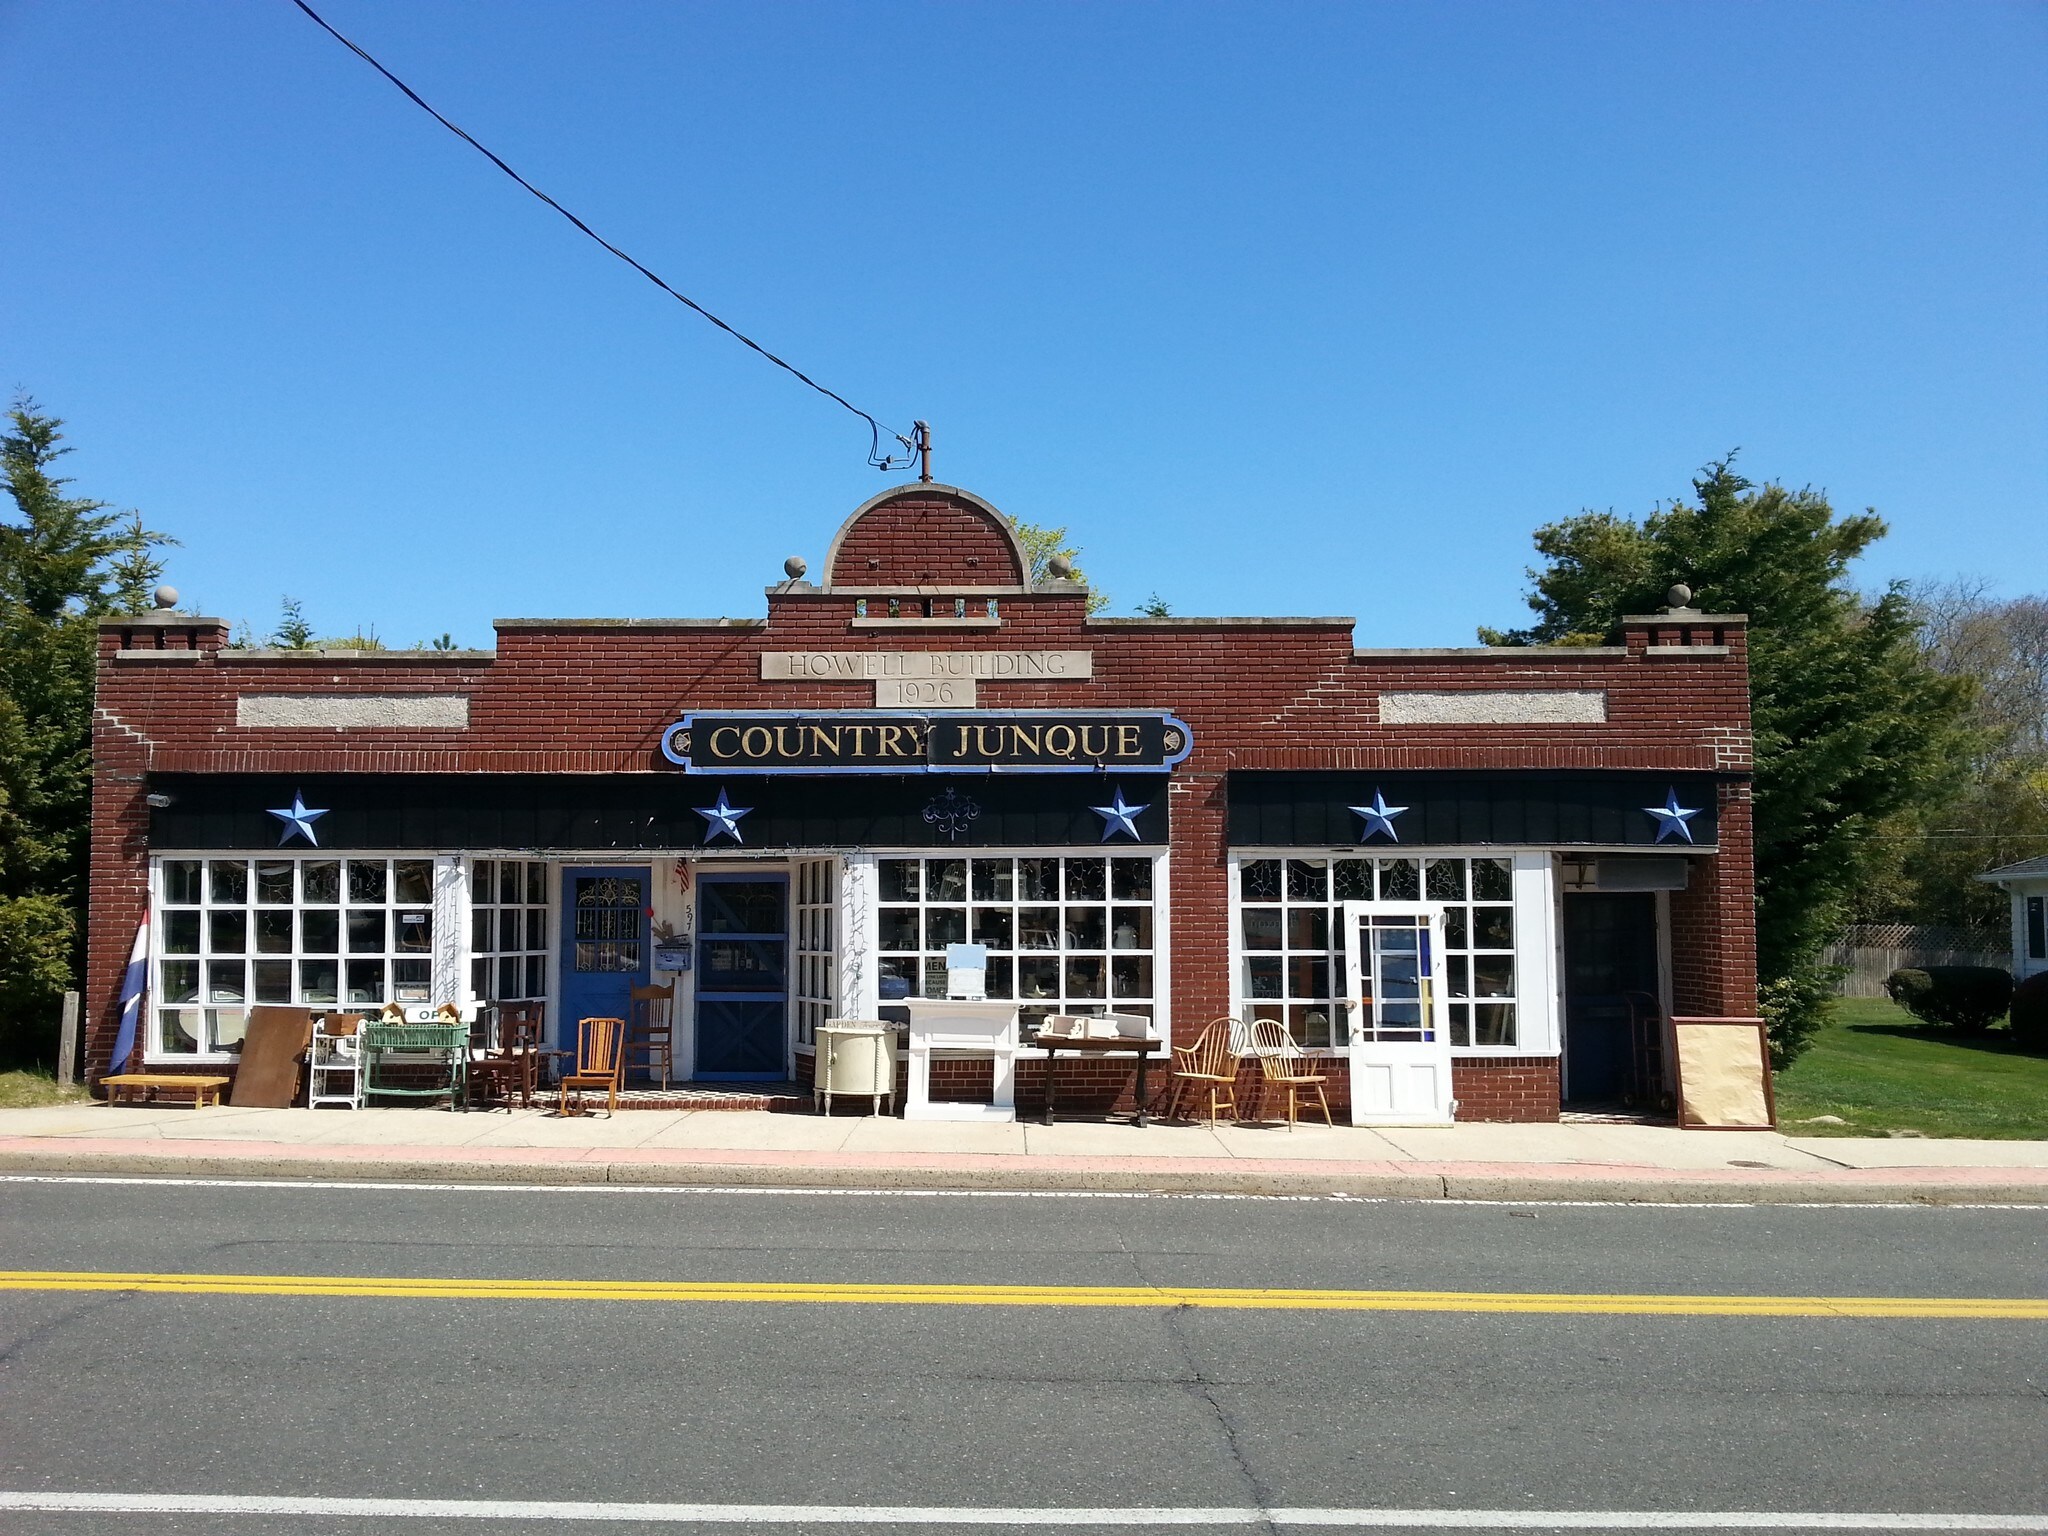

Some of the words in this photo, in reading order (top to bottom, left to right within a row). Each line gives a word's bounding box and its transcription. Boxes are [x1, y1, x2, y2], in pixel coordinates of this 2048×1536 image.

[788, 654, 912, 676] HOWELL
[930, 653, 1065, 676] BUILDING
[897, 682, 953, 703] 1926
[709, 725, 937, 758] COUNTRY
[952, 724, 1143, 760] JUNQUE
[685, 904, 693, 931] 597
